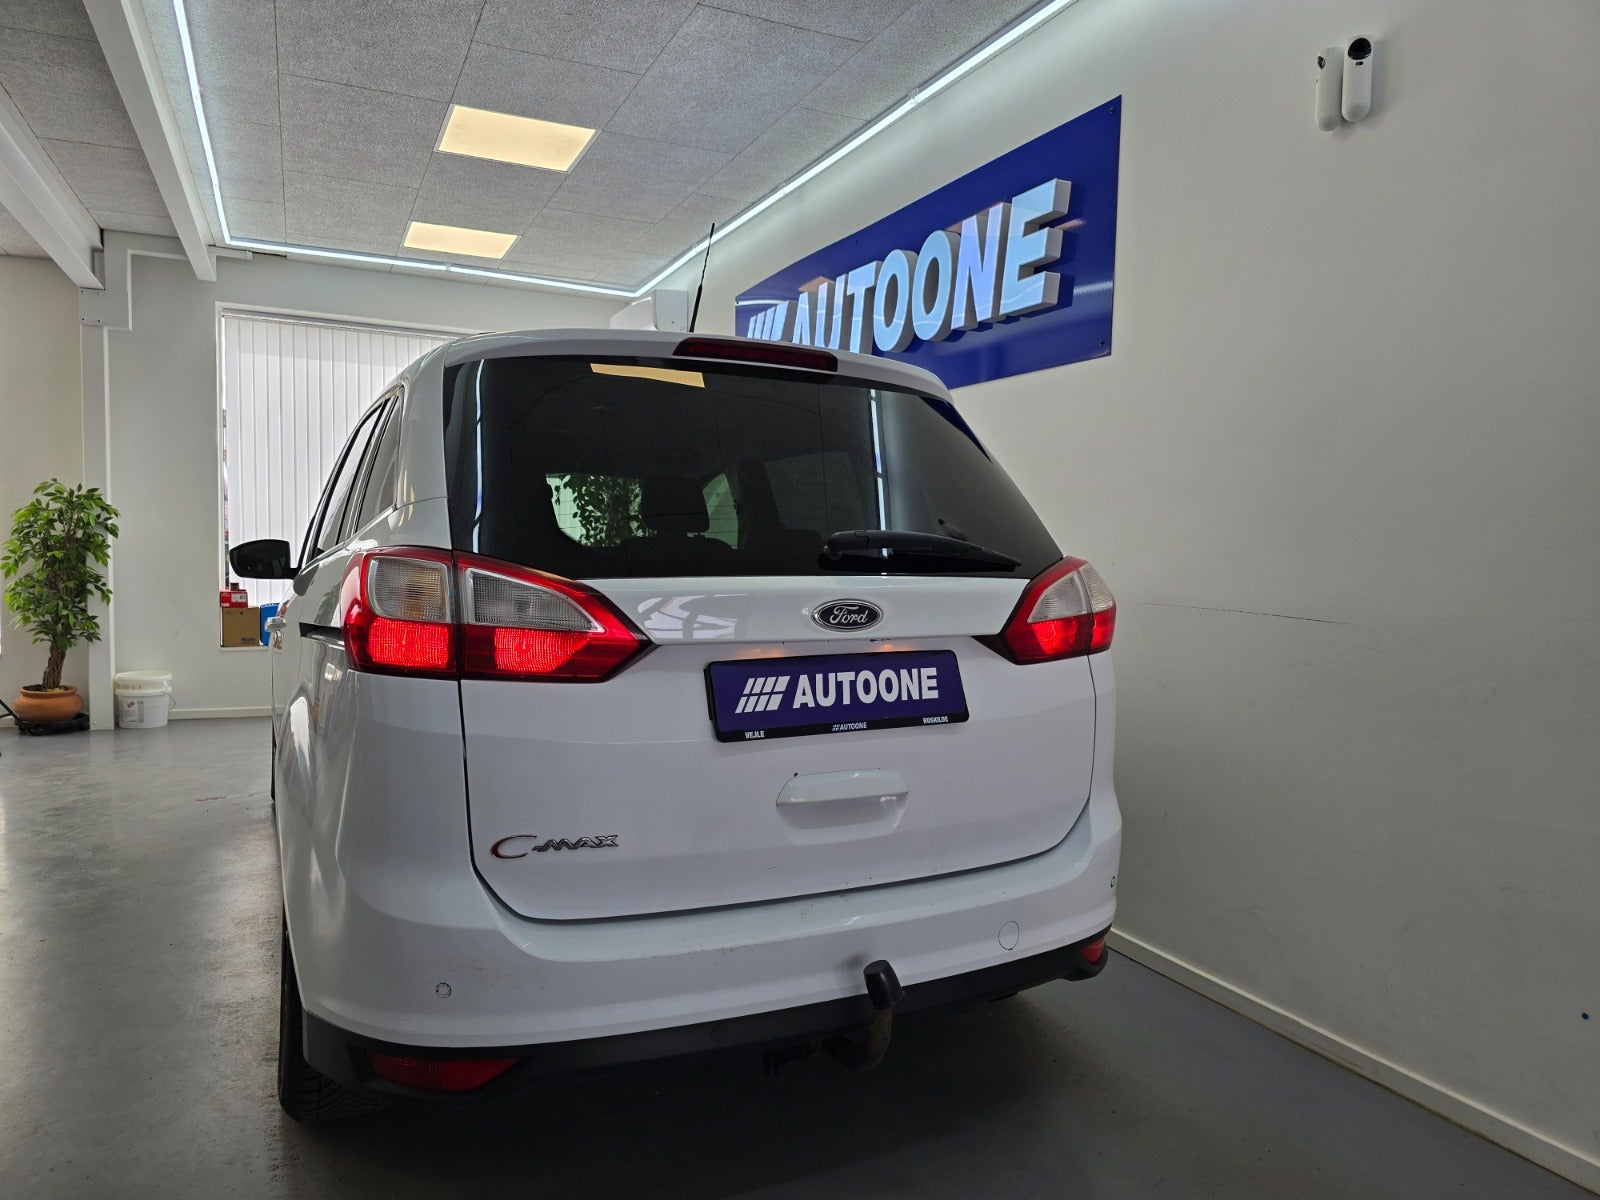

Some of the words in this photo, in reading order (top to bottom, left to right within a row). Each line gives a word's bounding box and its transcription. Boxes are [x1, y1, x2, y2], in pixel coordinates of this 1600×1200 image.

[792, 178, 1071, 354] AUTOONE
[829, 605, 868, 624] Ford
[792, 667, 939, 709] AUTOONE
[839, 721, 868, 731] AUTOONE
[922, 715, 949, 725] ROSKILDE
[744, 731, 765, 739] VEJLE
[490, 834, 619, 859] C-MAX
